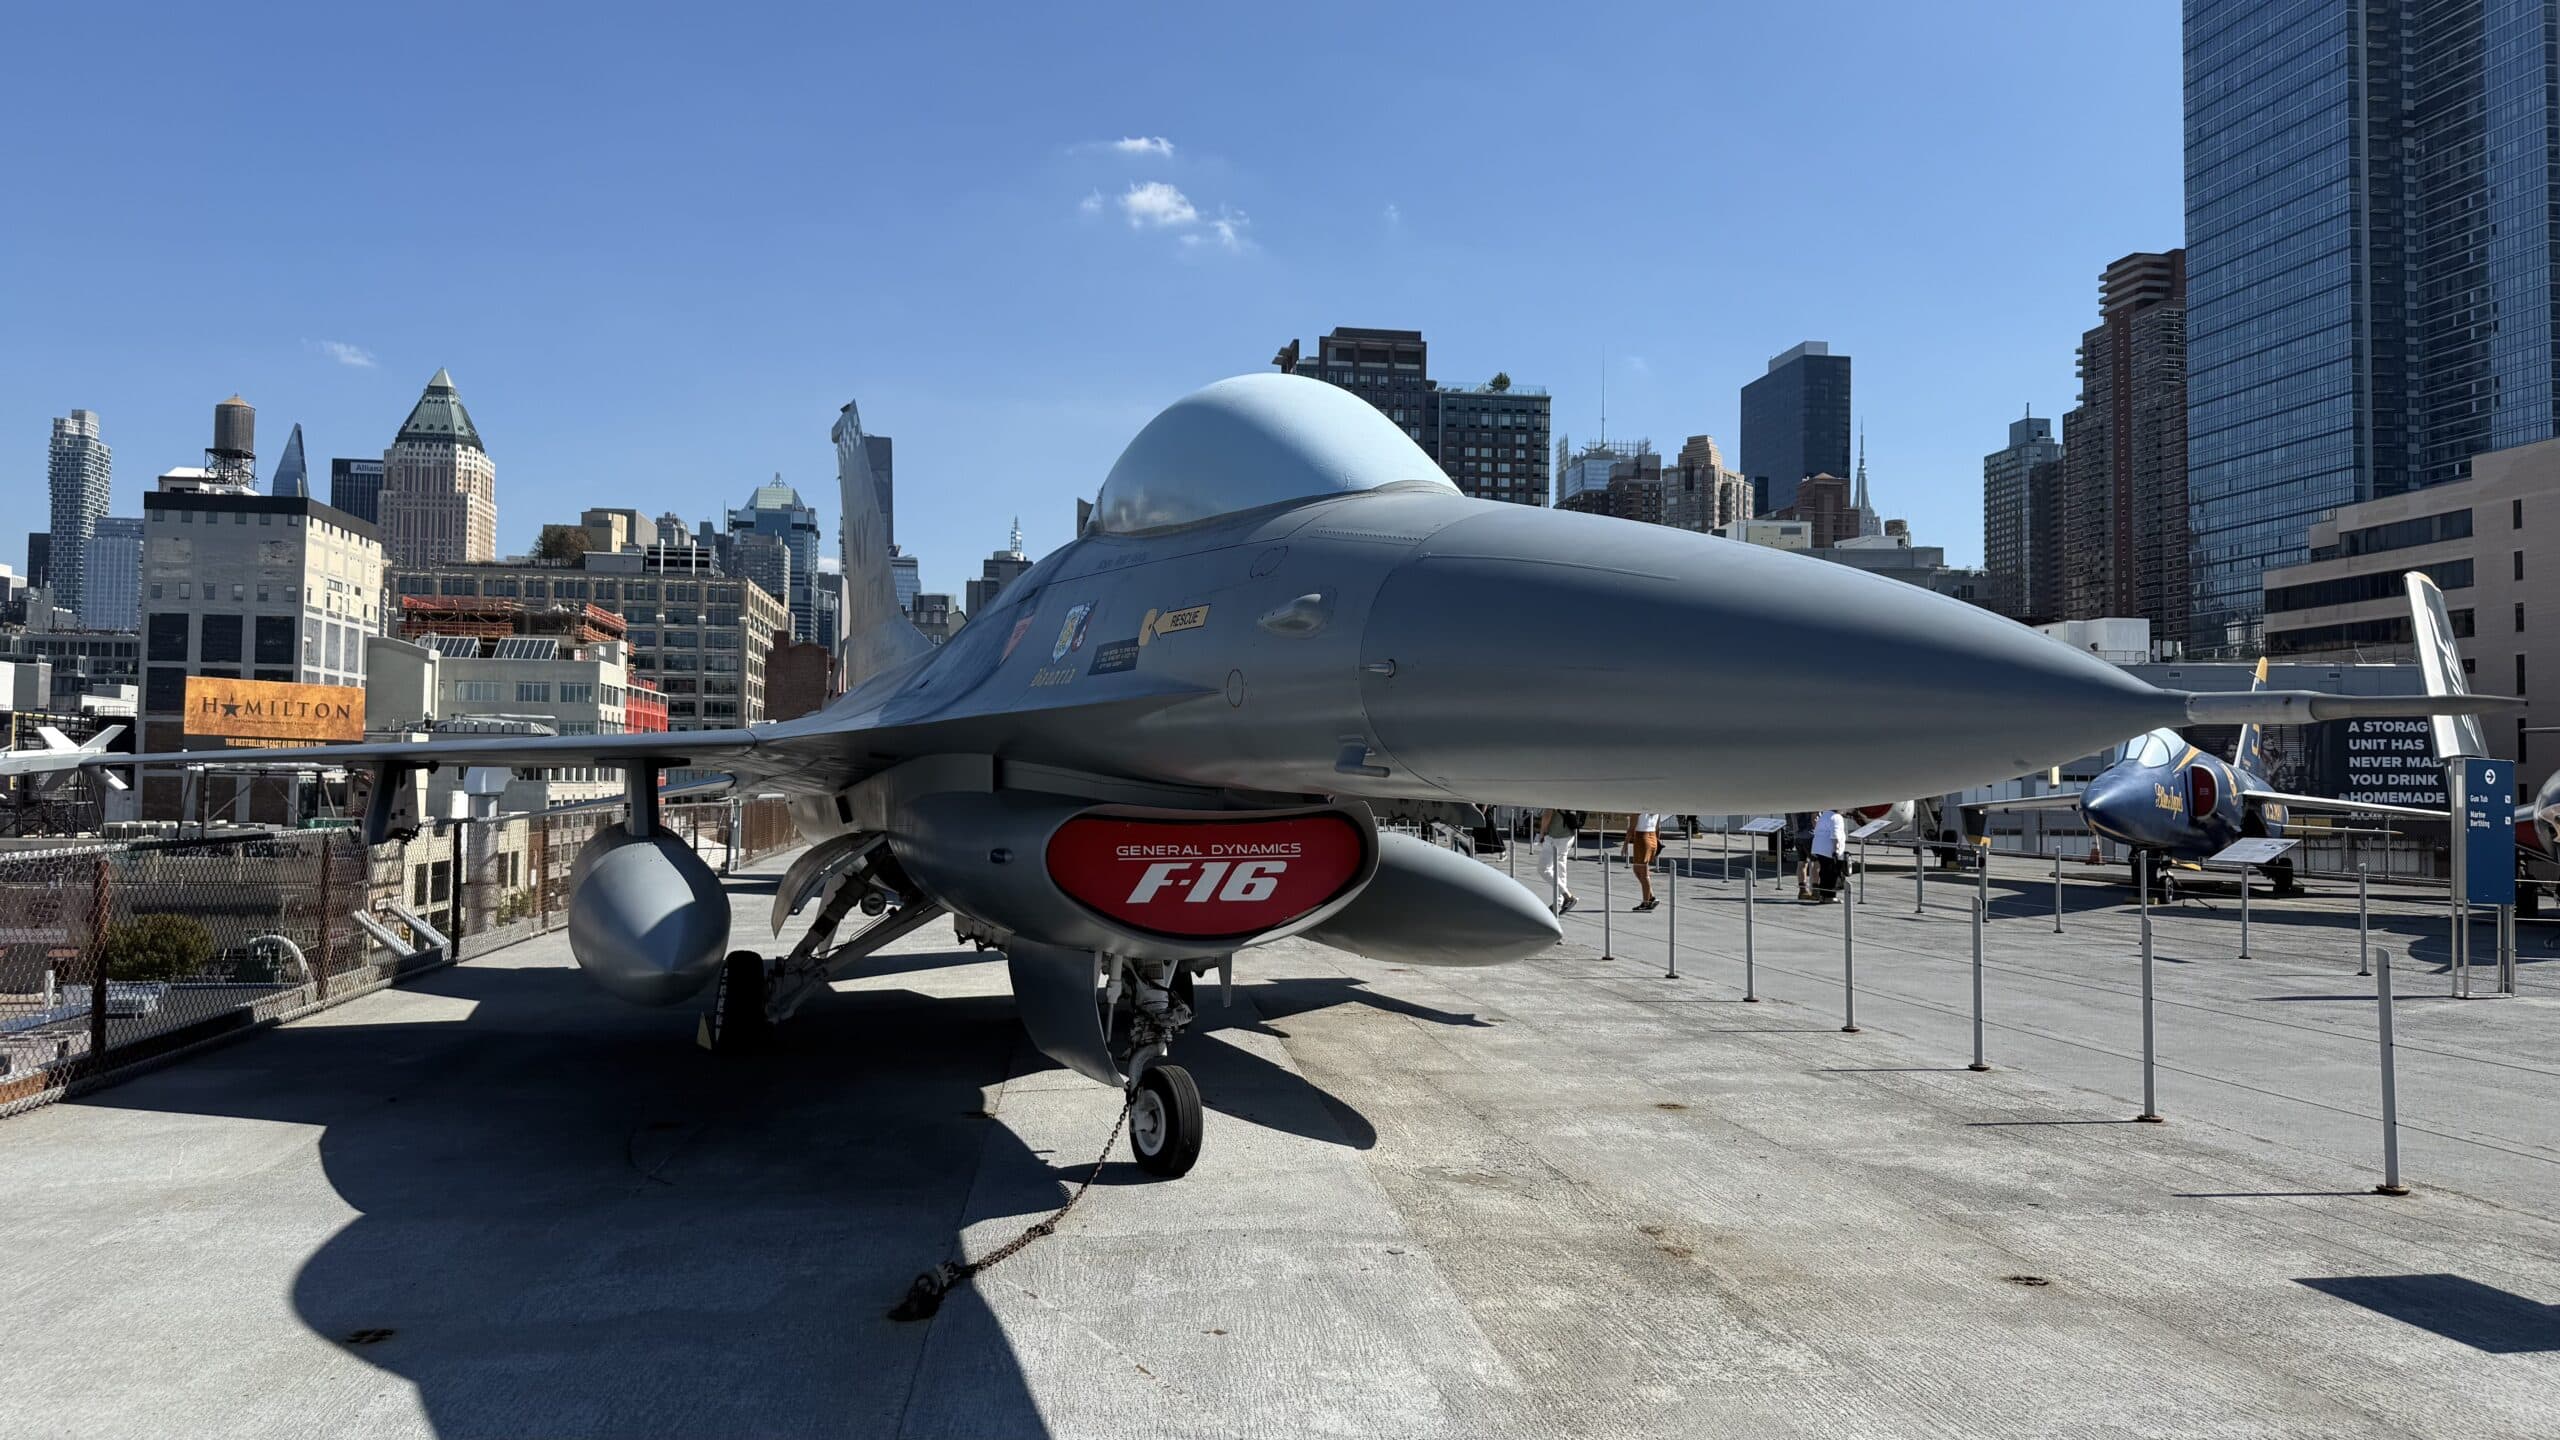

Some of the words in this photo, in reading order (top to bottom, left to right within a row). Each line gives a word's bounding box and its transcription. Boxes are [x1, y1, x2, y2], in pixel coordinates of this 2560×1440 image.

[1170, 610, 1200, 627] RESCUE
[2348, 721, 2360, 733] A
[2363, 721, 2428, 733] STORAG
[2349, 739, 2387, 750] UNIT
[2391, 739, 2425, 750] HAS
[2349, 757, 2402, 768] NEVER
[2406, 757, 2443, 768] MAD
[2349, 774, 2383, 785] YOU
[2387, 774, 2439, 785] DRINK
[2350, 791, 2445, 804] HOMEMADE
[1116, 844, 1202, 856] GENERAL
[1211, 843, 1301, 855] DYNAMICS
[1125, 860, 1287, 904] F-16
